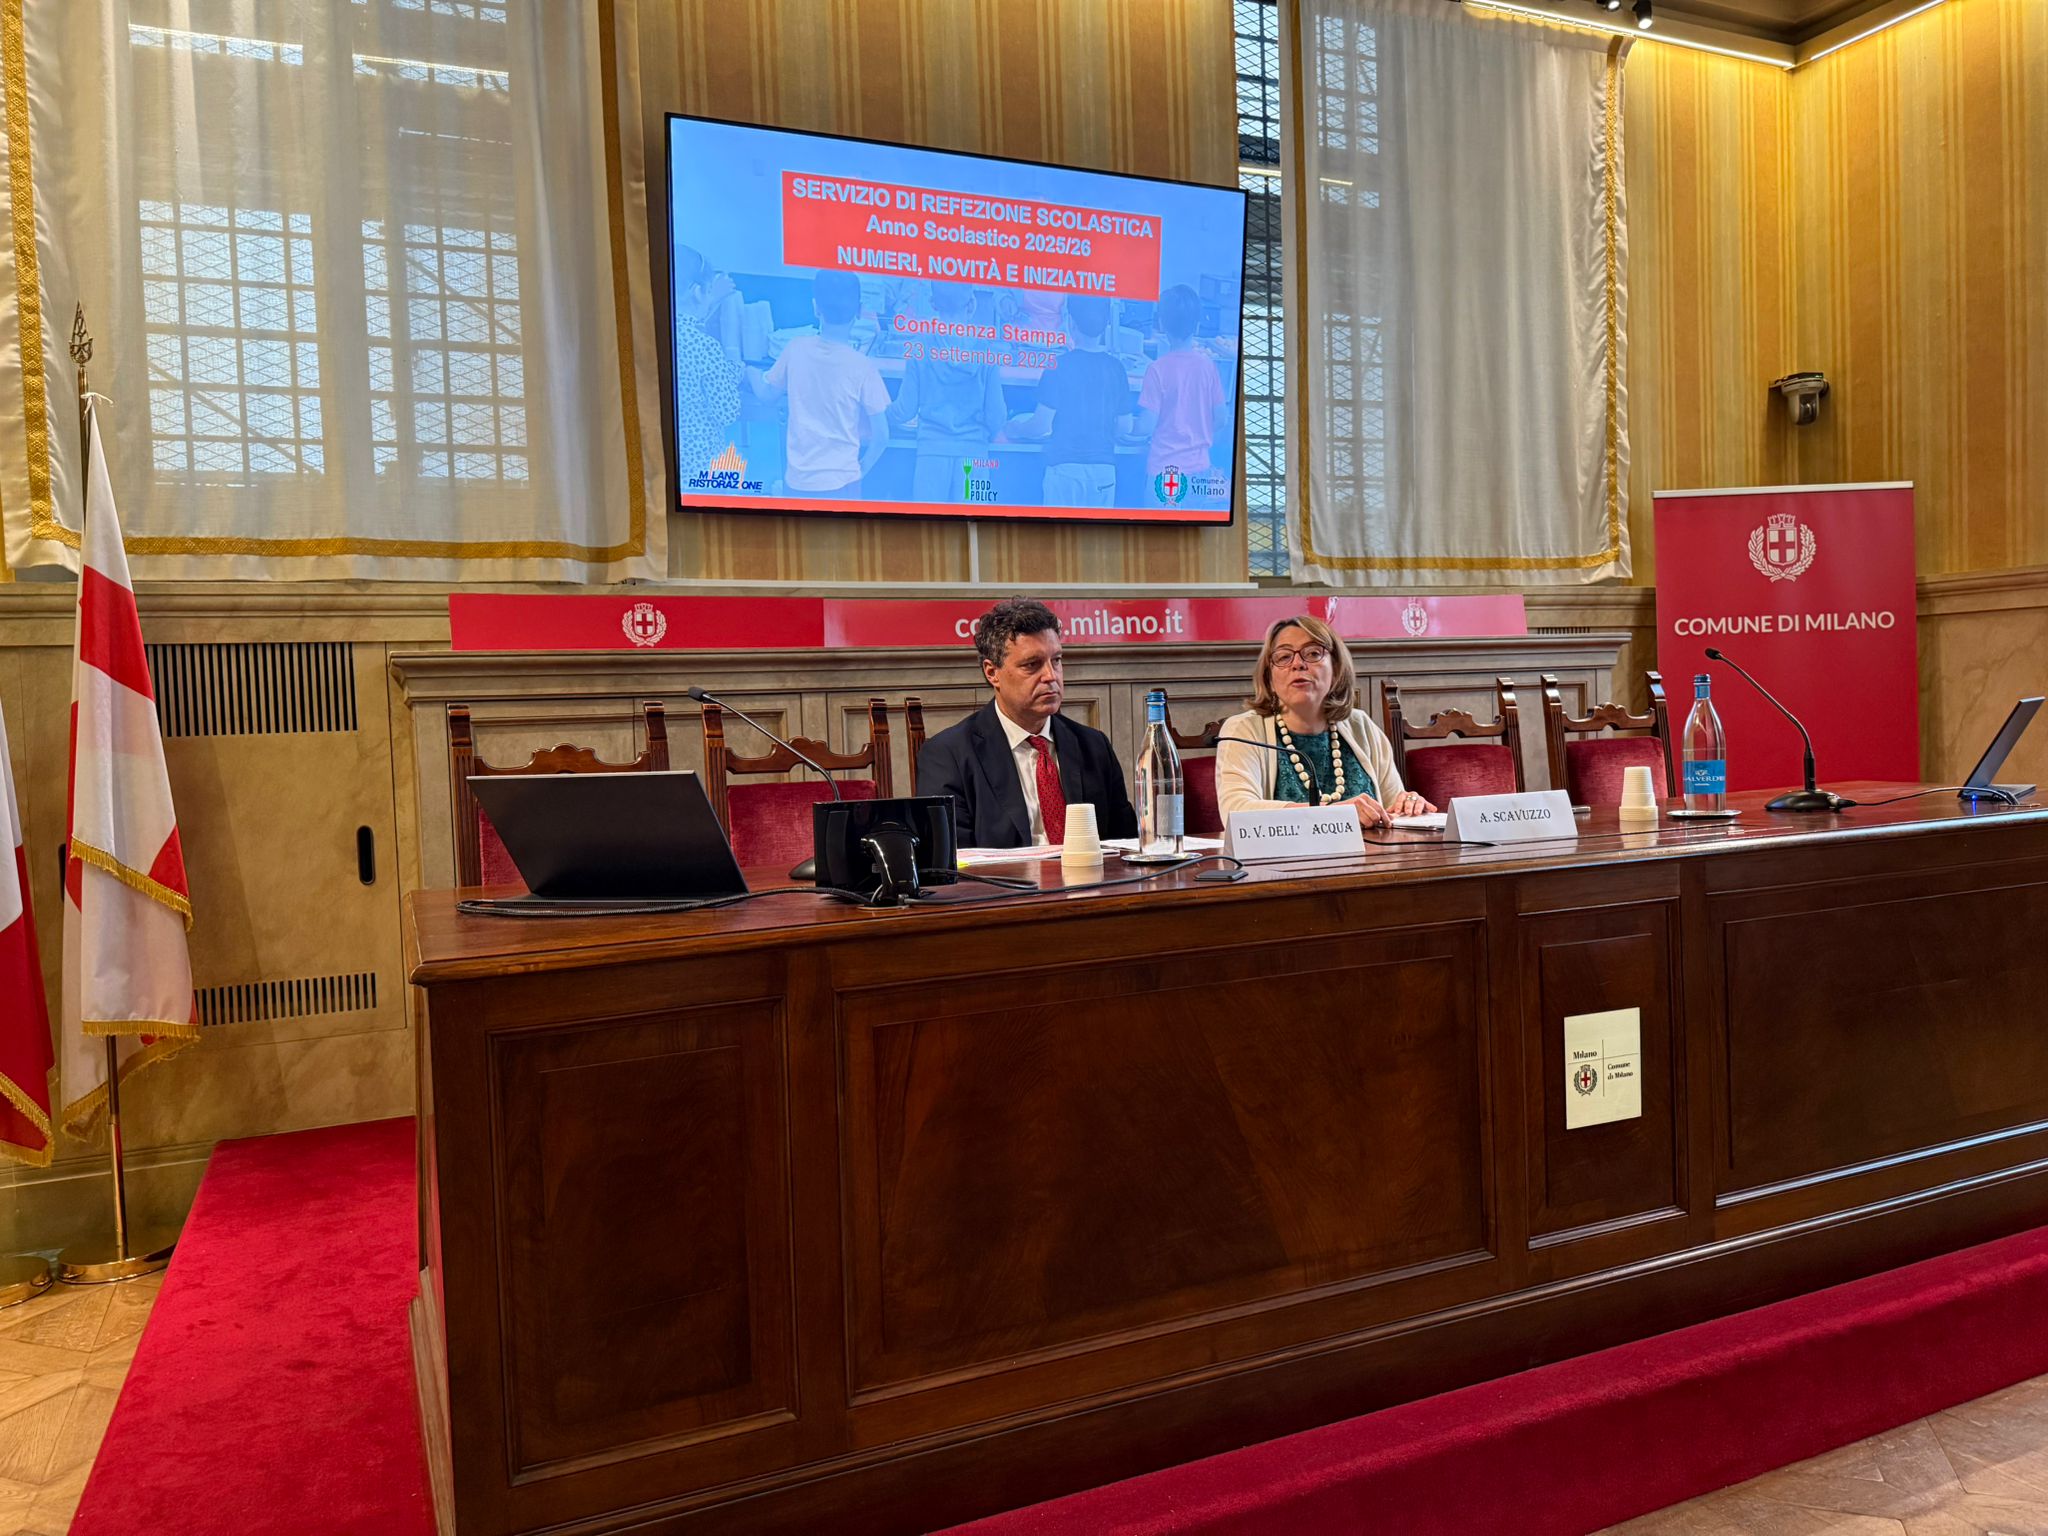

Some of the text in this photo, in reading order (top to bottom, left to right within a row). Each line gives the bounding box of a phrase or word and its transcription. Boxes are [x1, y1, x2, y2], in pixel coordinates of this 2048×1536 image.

[792, 177, 1153, 238] SERVIZIO DI REFEZIONE SCOLASTICA
[866, 214, 1092, 257] Anno Scolastico 2025/26
[837, 245, 1116, 292] NUMERI, NOVITÀ E INIZIATIVE
[893, 314, 1067, 348] Conferenza Stampa
[903, 342, 1058, 370] 23 settembre 2025
[970, 480, 991, 491] FOOD
[1191, 476, 1219, 485] Comune
[970, 490, 998, 502] POLICY
[1191, 485, 1225, 496] Milano
[1674, 611, 1895, 636] COMUNE DI MILANO
[1480, 808, 1551, 823] A. SCAVUZZO
[1239, 822, 1354, 839] D. V. DELL' ACQUA
[1573, 1050, 1598, 1060] Milano
[1607, 1062, 1631, 1070] Comune
[1607, 1071, 1634, 1080] di Milano
